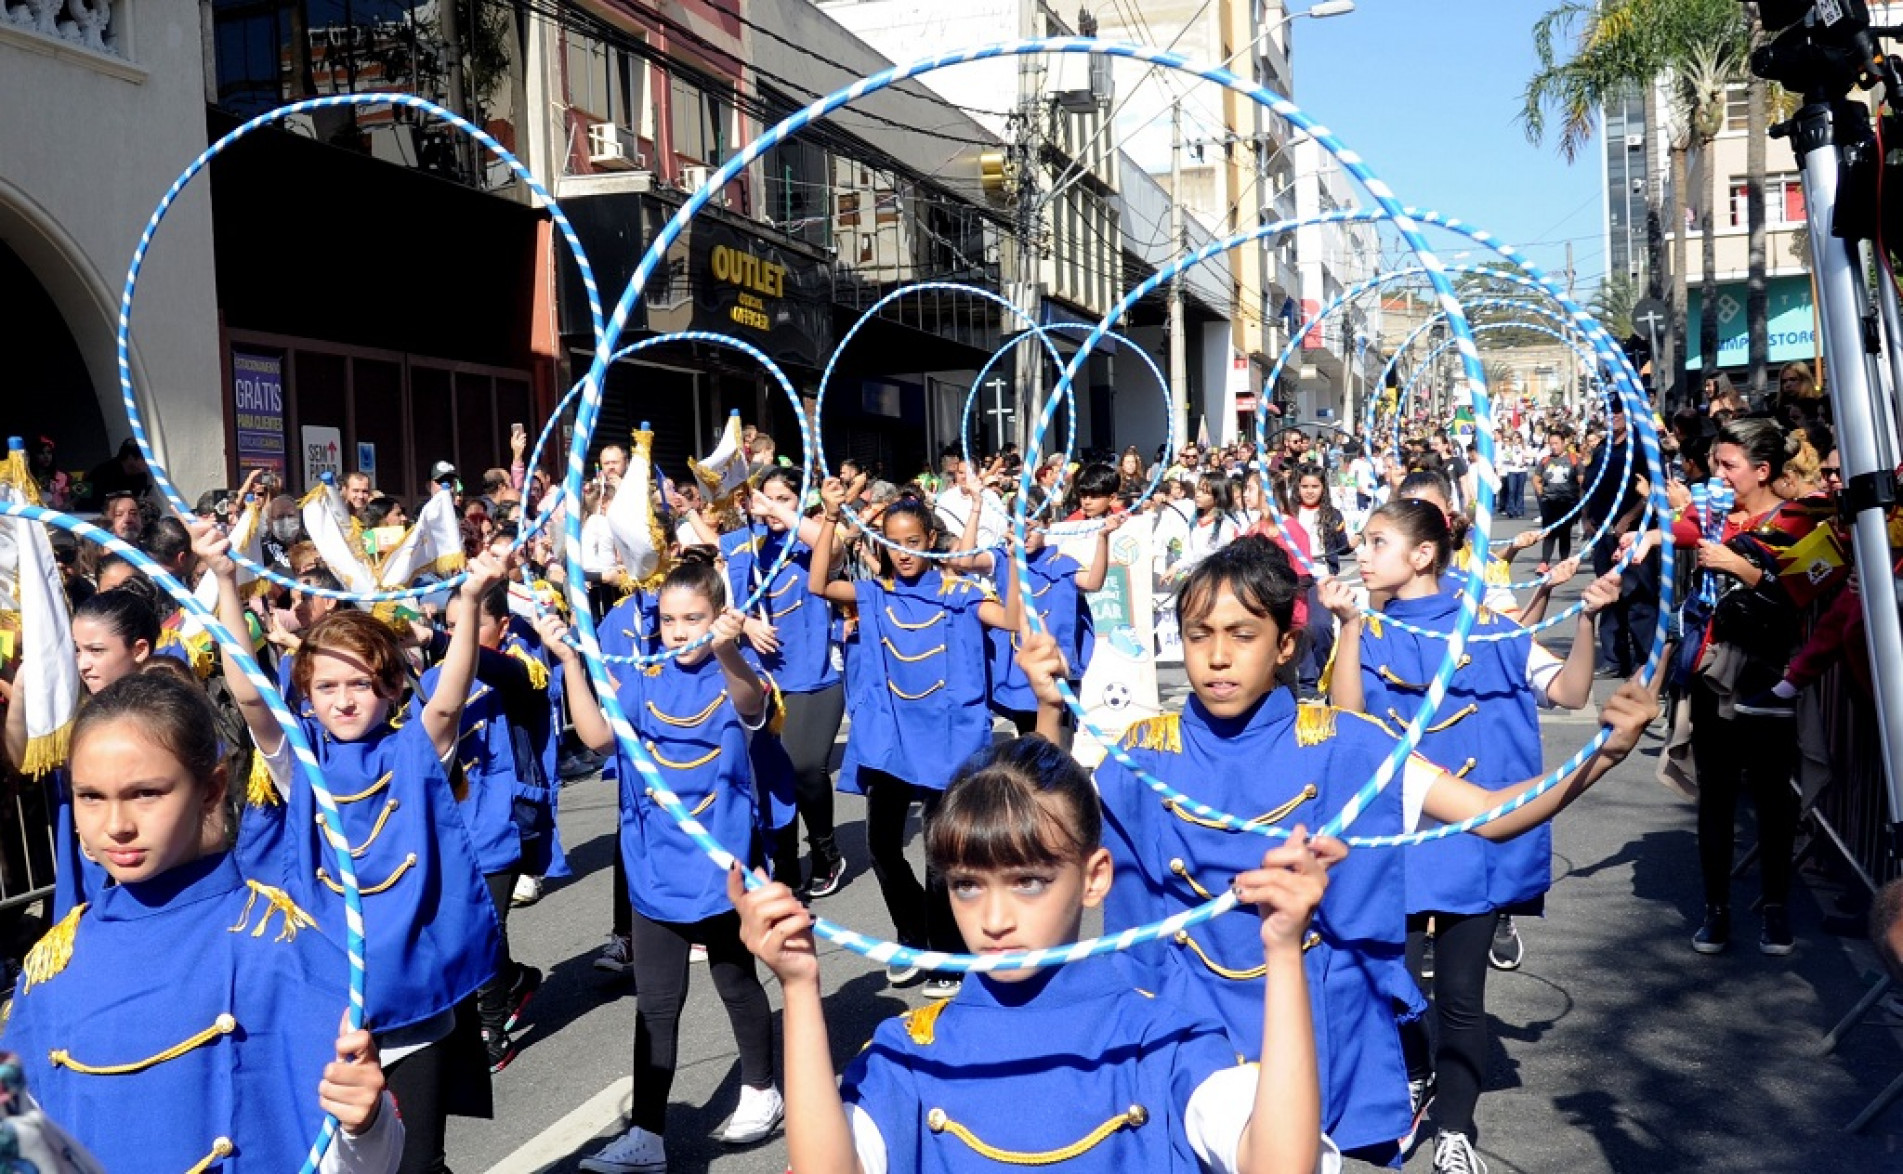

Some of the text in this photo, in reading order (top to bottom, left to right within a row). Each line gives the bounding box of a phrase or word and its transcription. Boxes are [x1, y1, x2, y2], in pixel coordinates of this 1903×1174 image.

[712, 245, 786, 298] OUTLET
[236, 377, 282, 412] GRÁTIS
[308, 444, 327, 463] SEM
